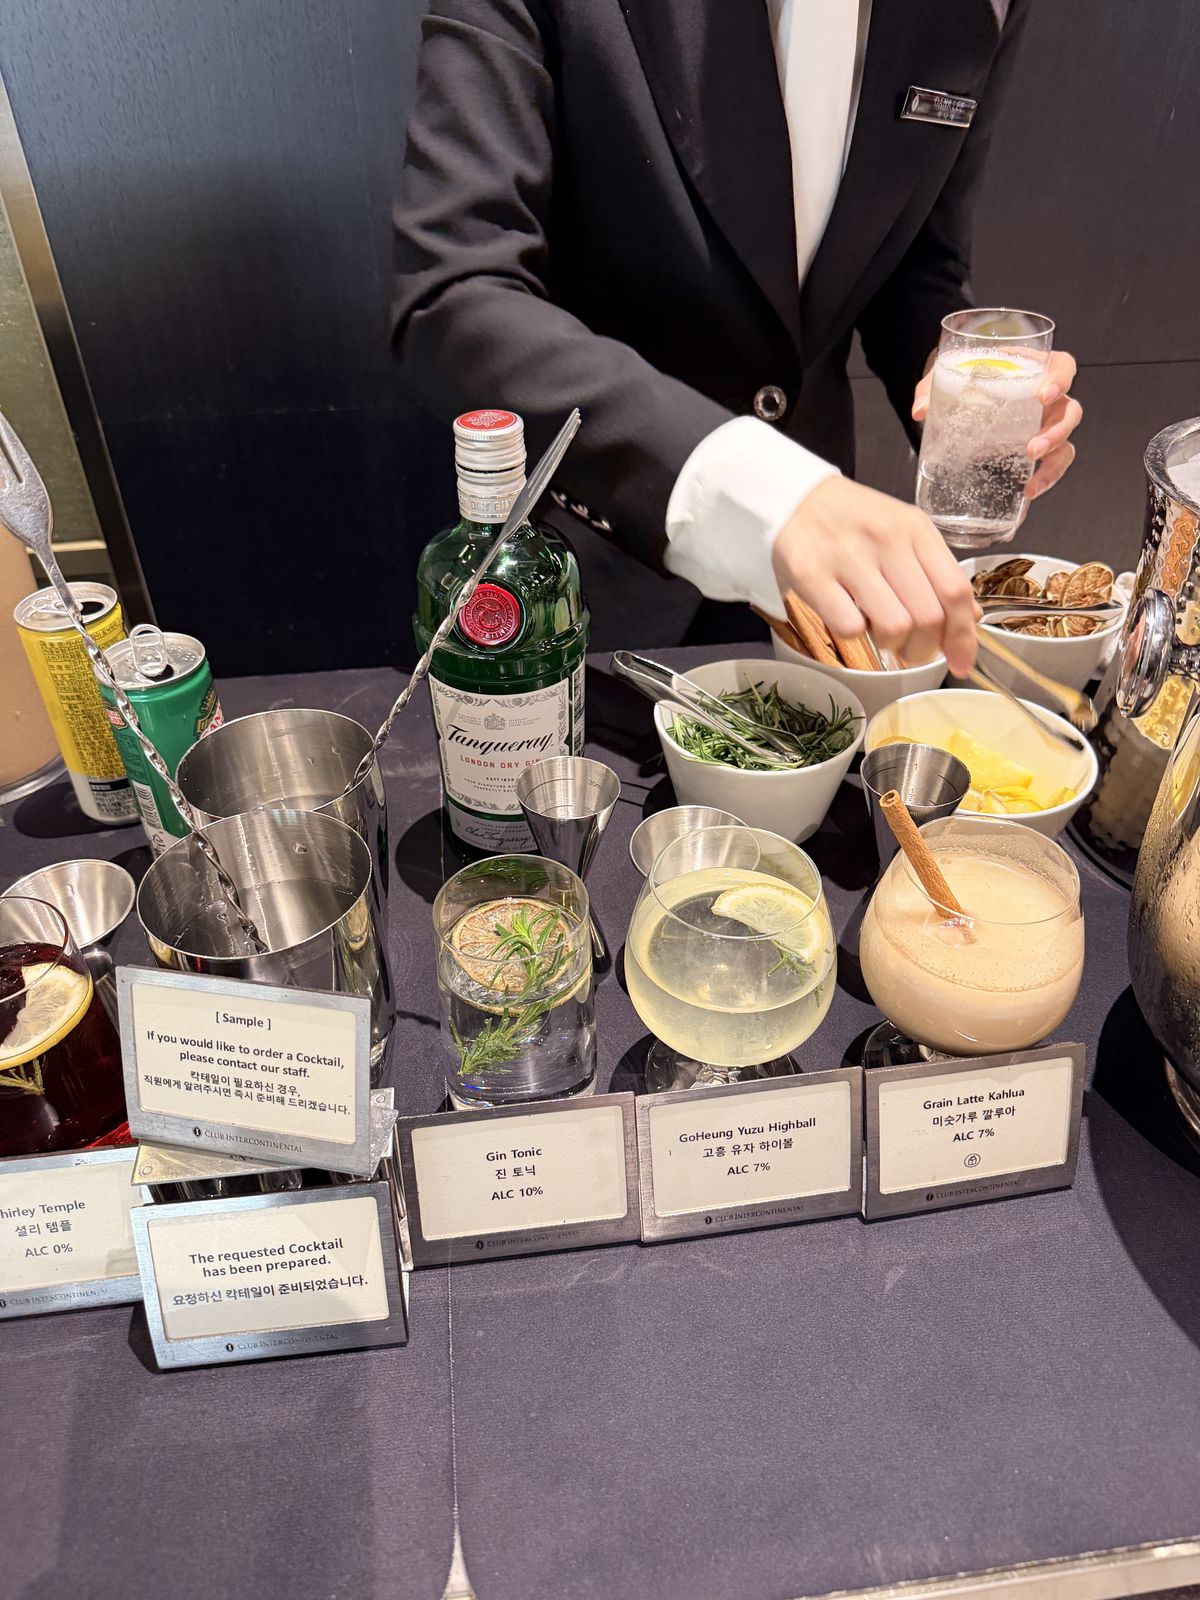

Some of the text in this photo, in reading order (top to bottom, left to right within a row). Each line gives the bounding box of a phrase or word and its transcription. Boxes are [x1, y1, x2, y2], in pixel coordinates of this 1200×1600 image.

[447, 723, 554, 755] Tanqueray
[460, 755, 495, 768] LONDON
[500, 761, 520, 769] DRY
[222, 1013, 264, 1028] Sample
[147, 1030, 345, 1070] If you would like to order a Cocktail,
[179, 1051, 310, 1079] please contact our staff.
[190, 1070, 301, 1097] 칵테일이 필요하신 경우,
[144, 1075, 351, 1116] 직원에게 알려주시면 즉시 준비해 드리겠습니다.
[923, 1088, 1025, 1110] Grain Latte Kahlua
[932, 1105, 1016, 1127] 미숫가루 깔루아
[679, 1117, 816, 1143] GoHeung Yuzu Highball
[952, 1127, 995, 1142] ALC 7%
[486, 1146, 542, 1162] Gin Tonic
[703, 1138, 794, 1158] 고흥 유자 하이볼
[495, 1165, 536, 1180] 진 토닉
[727, 1162, 771, 1176] ALC 7%
[491, 1186, 544, 1201] ALC 10%
[0, 1200, 86, 1219] hirley Temple
[15, 1219, 72, 1238] 셜리 템플
[25, 1243, 74, 1258] ALC 0%
[189, 1238, 344, 1265] The requested Cocktail
[203, 1255, 331, 1278] has been prepared.
[173, 1274, 369, 1306] 요청하신 칵테일이 준비되었습니다.
